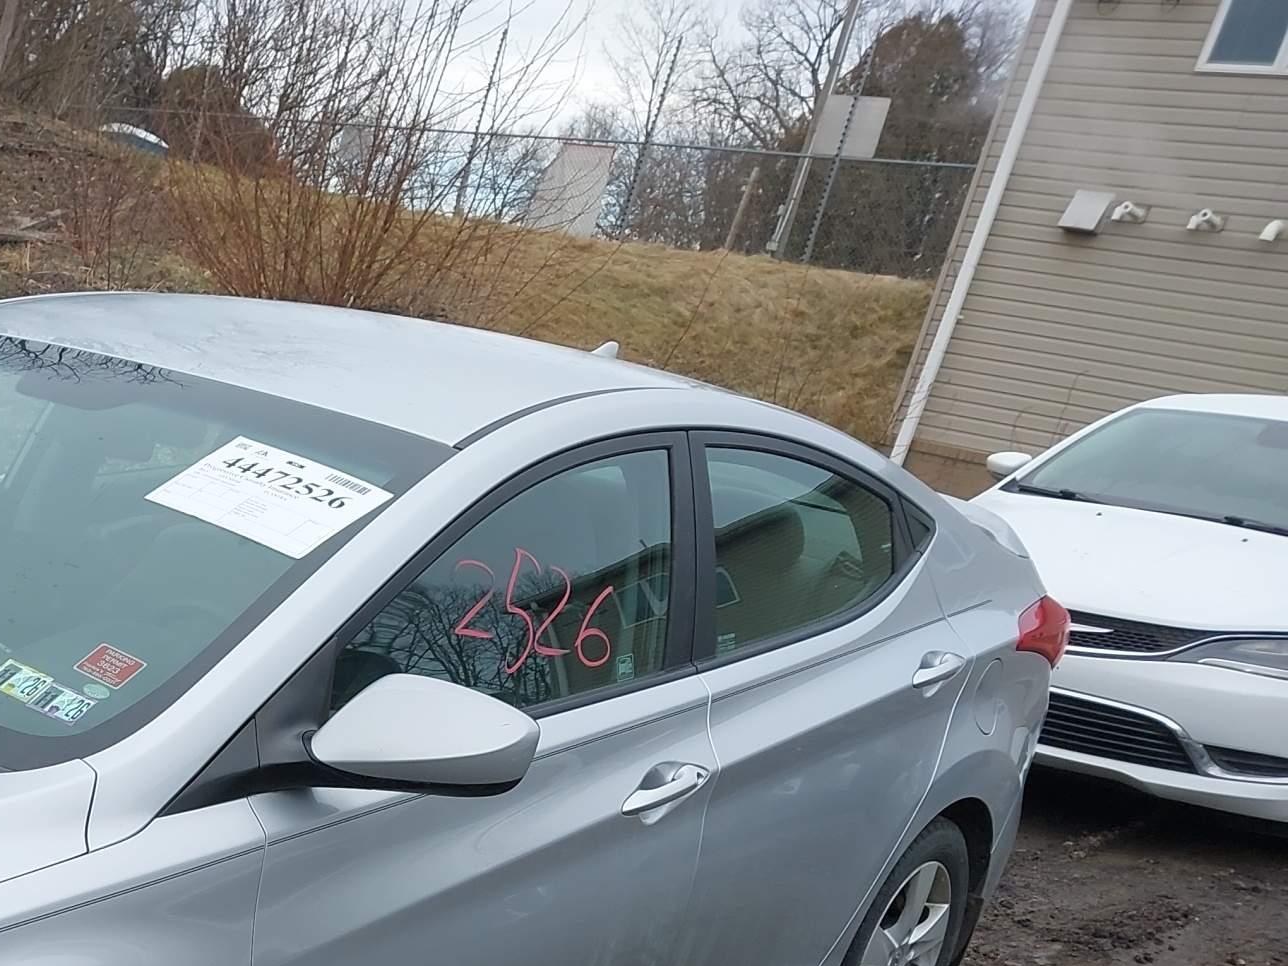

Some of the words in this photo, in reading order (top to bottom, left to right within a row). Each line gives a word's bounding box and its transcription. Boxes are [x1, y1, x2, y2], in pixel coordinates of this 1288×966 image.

[221, 456, 348, 510] 44472526
[454, 547, 614, 674] 2526
[20, 677, 47, 697] 26
[65, 699, 91, 720] 26
